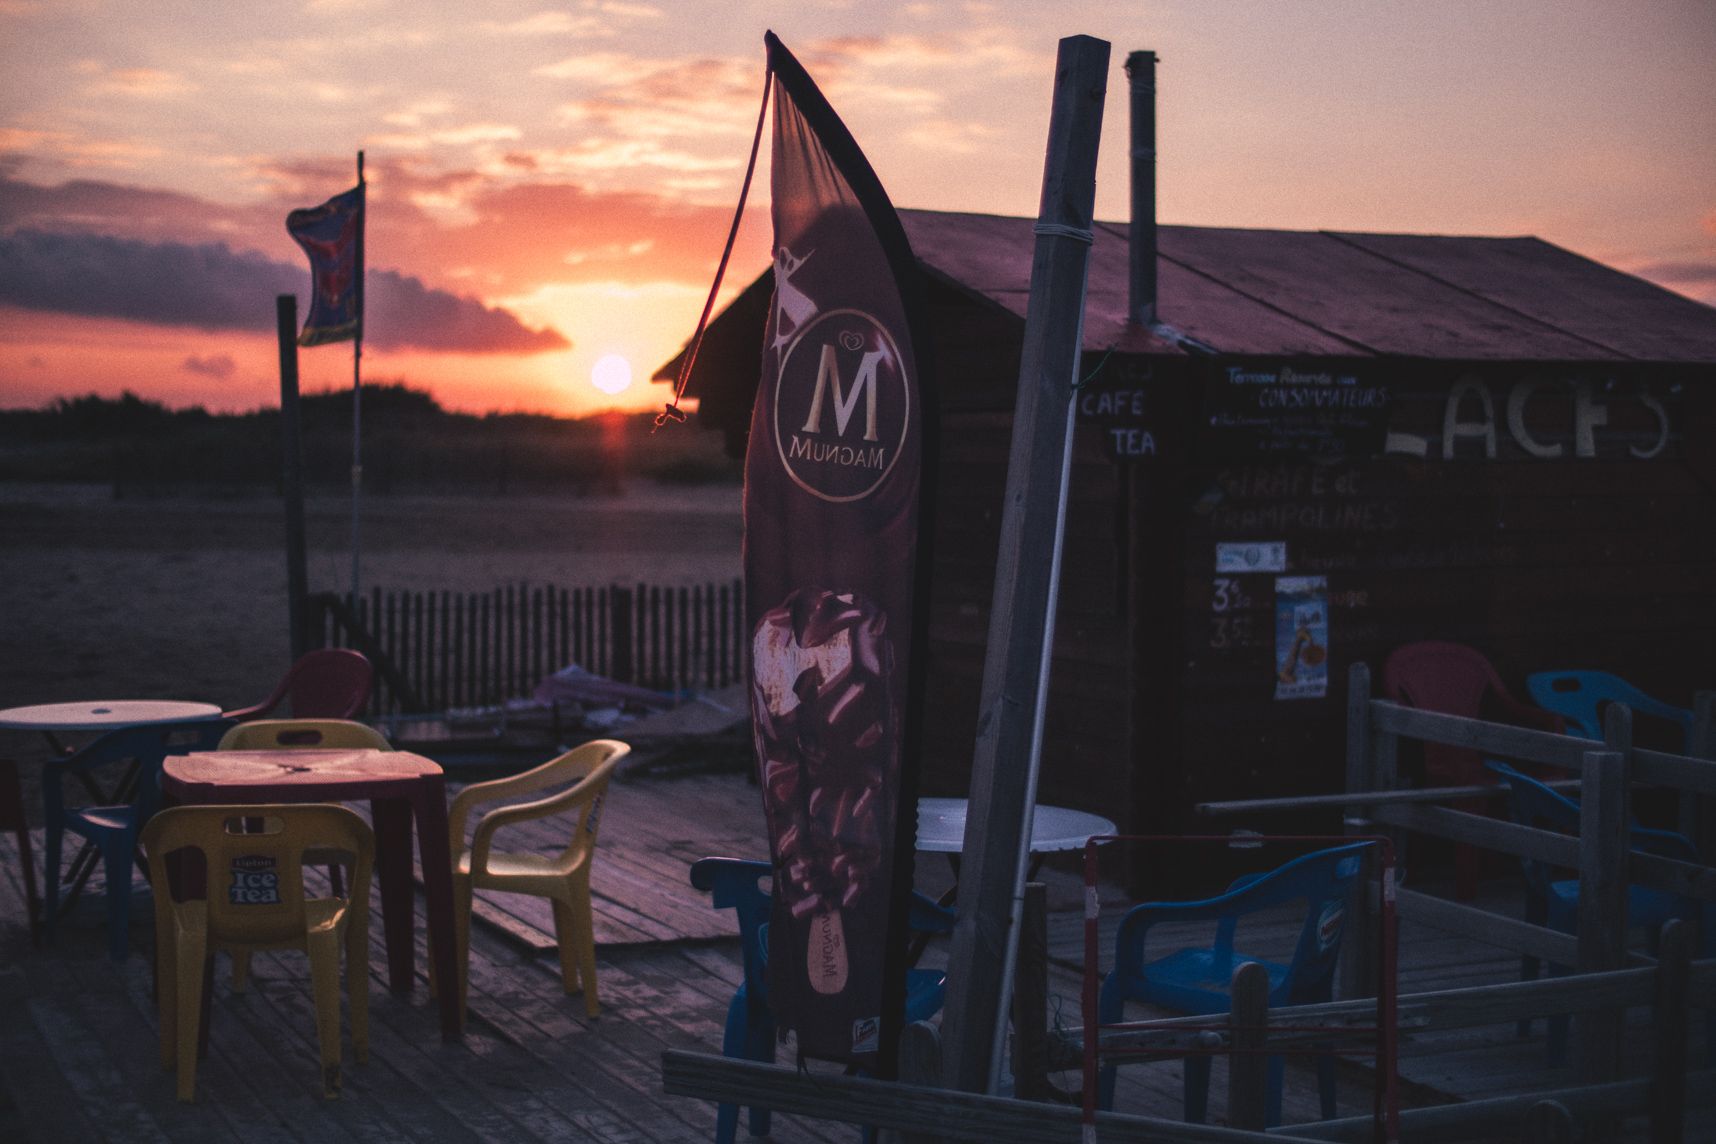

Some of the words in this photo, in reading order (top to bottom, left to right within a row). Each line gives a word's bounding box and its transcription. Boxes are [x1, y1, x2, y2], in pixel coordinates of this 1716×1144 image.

[1109, 427, 1157, 455] TEA
[235, 872, 277, 888] Ice
[231, 887, 277, 903] Tea
